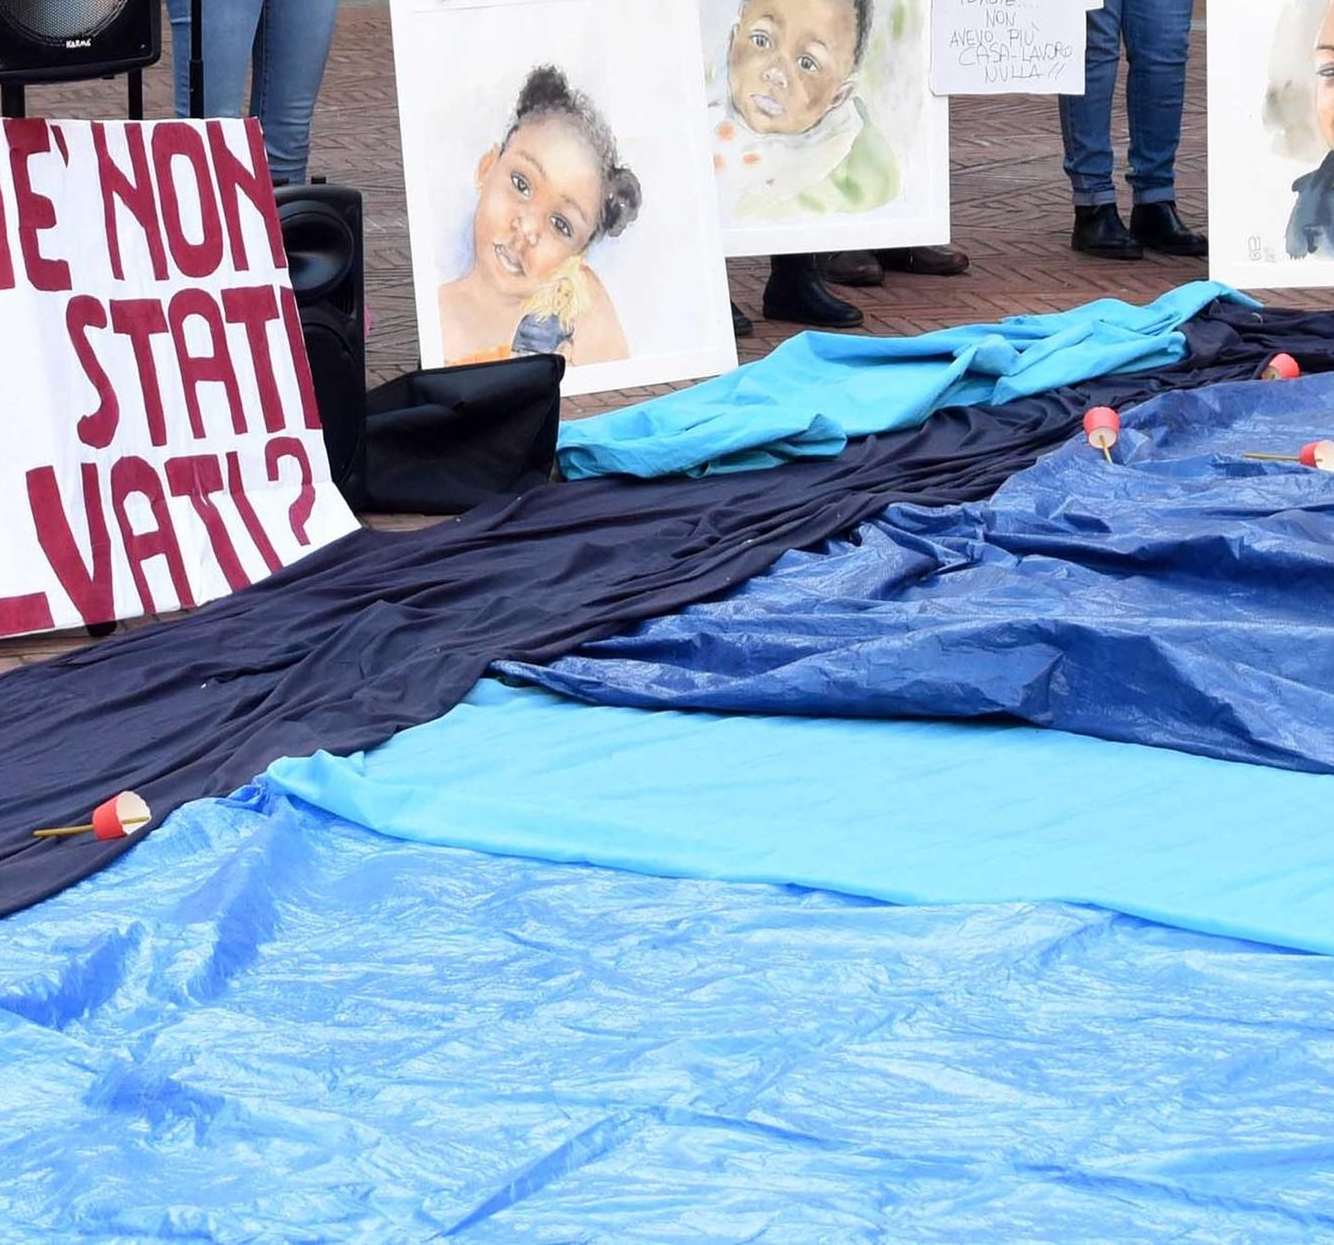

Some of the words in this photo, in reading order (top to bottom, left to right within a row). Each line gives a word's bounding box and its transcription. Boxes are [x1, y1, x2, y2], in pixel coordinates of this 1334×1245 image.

[949, 28, 994, 48] AVEVO
[986, 8, 1016, 28] NON
[91, 117, 288, 283] NON
[68, 285, 323, 448] STATI
